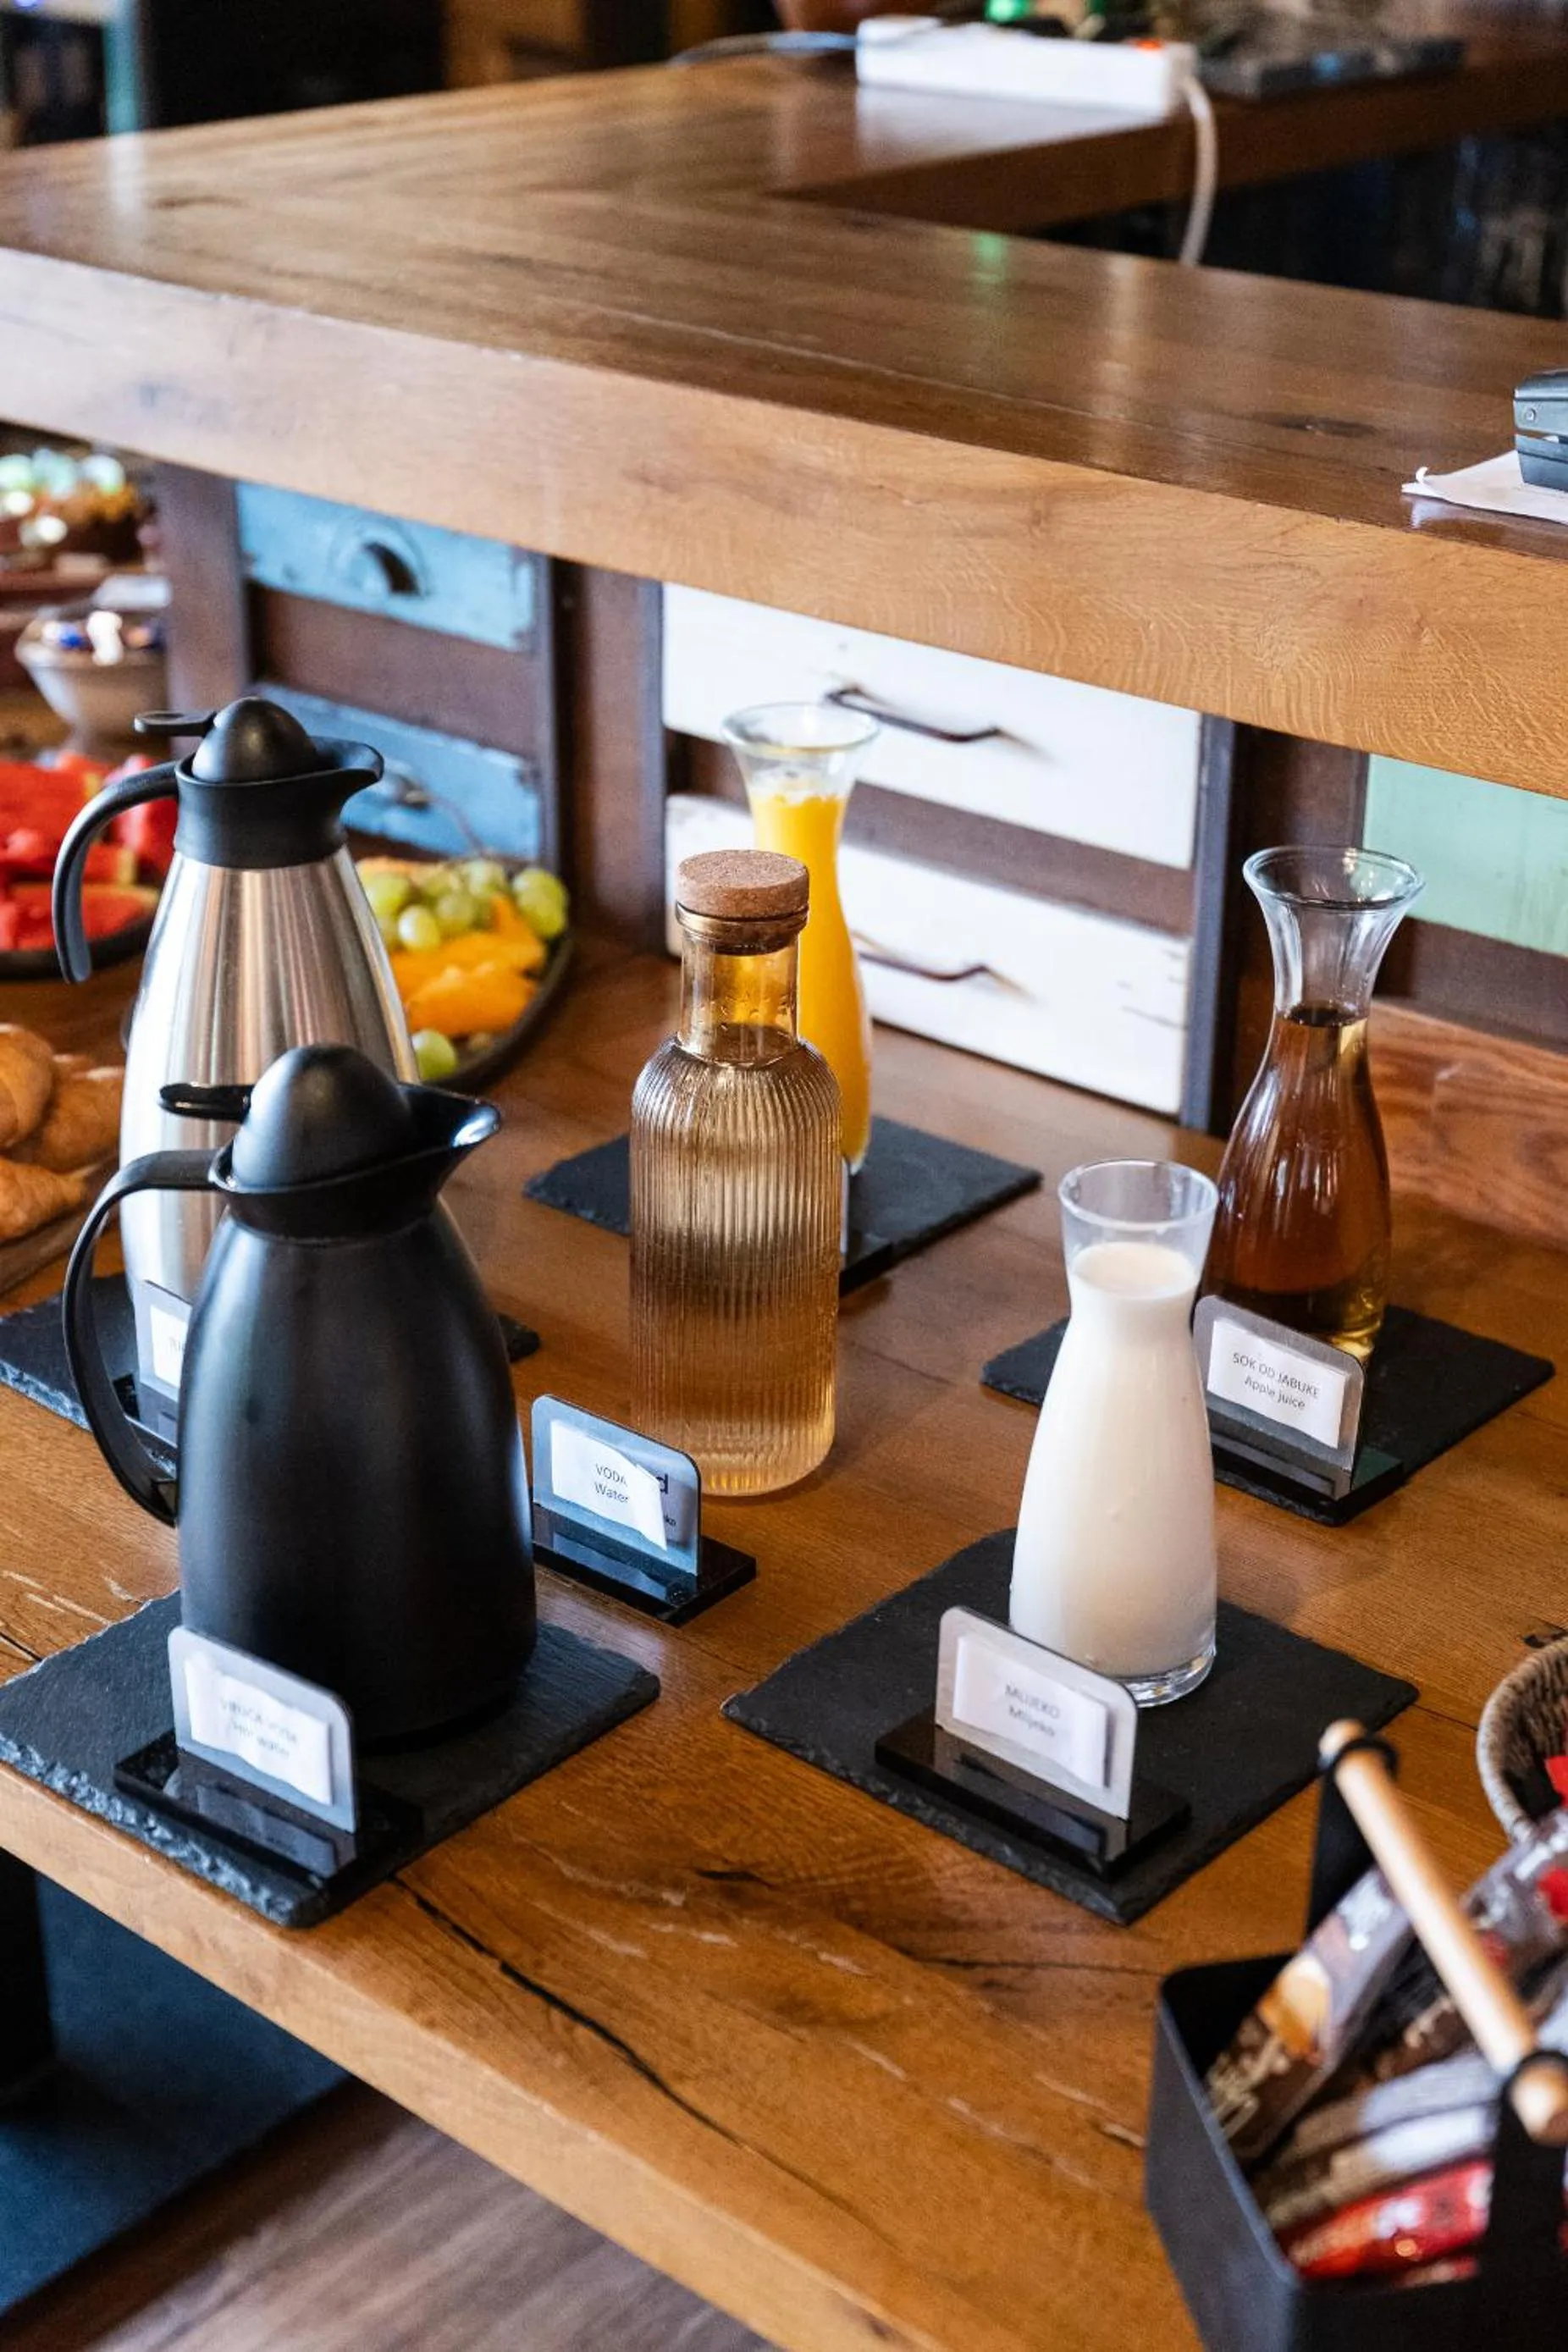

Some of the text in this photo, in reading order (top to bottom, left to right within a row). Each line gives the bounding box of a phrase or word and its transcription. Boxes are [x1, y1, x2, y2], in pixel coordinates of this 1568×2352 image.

[1232, 1352, 1321, 1400] SOK OD JABUKE
[1244, 1375, 1306, 1411] Apple juice
[595, 1462, 628, 1488] VODA
[594, 1482, 629, 1503] Water
